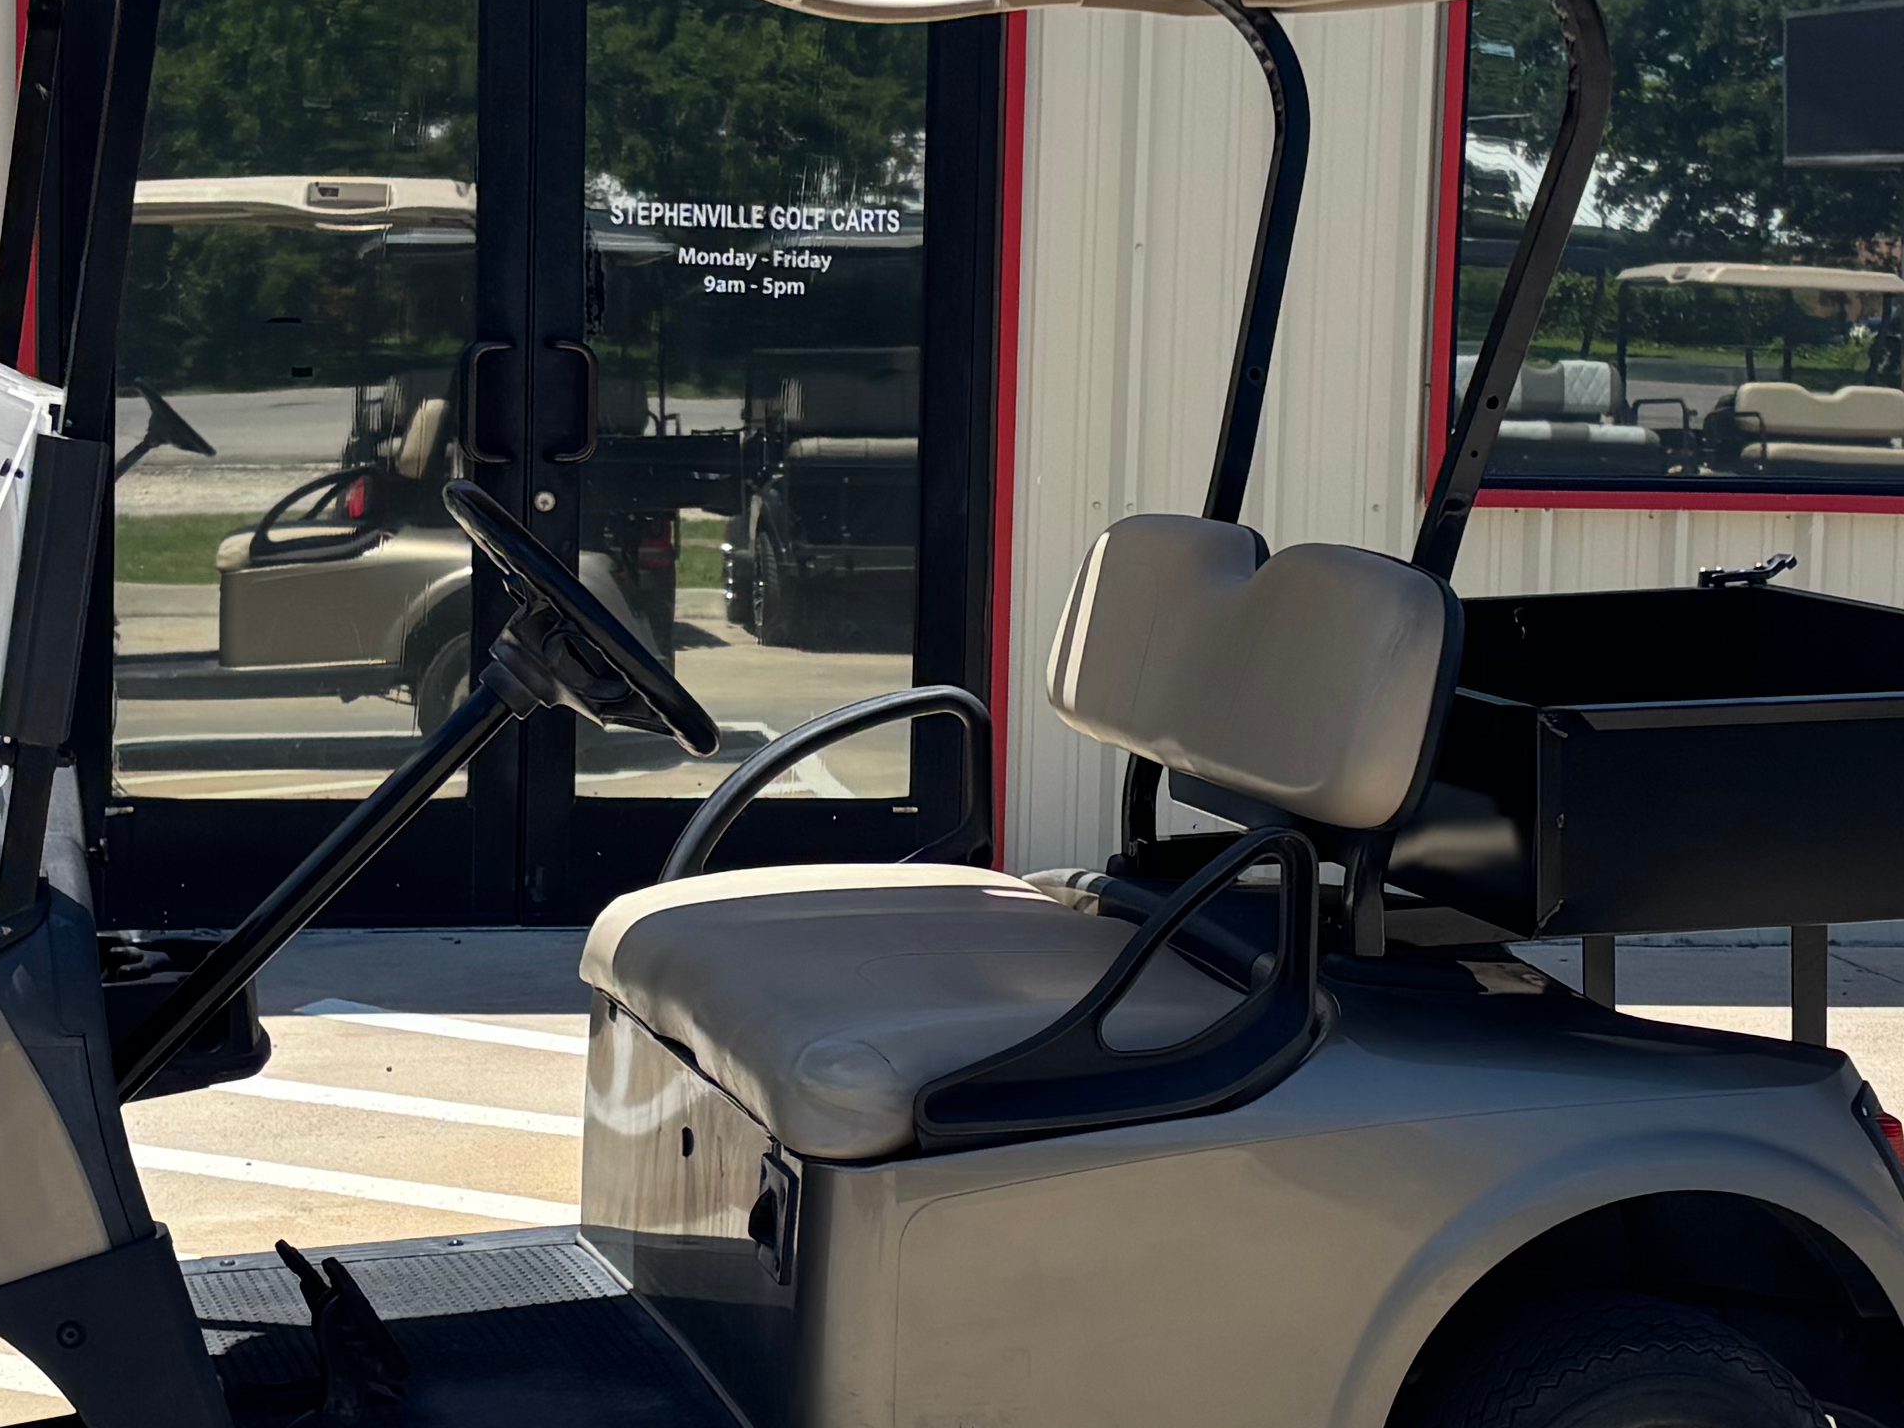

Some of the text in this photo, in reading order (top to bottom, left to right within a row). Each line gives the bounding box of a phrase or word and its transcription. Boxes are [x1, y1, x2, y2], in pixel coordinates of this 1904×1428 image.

[610, 202, 900, 233] STEPHENVILLE GOLF CARTS
[678, 248, 757, 270] Monday
[773, 249, 833, 272] Friday
[703, 275, 746, 294] 9am
[762, 277, 805, 298] 5pm
